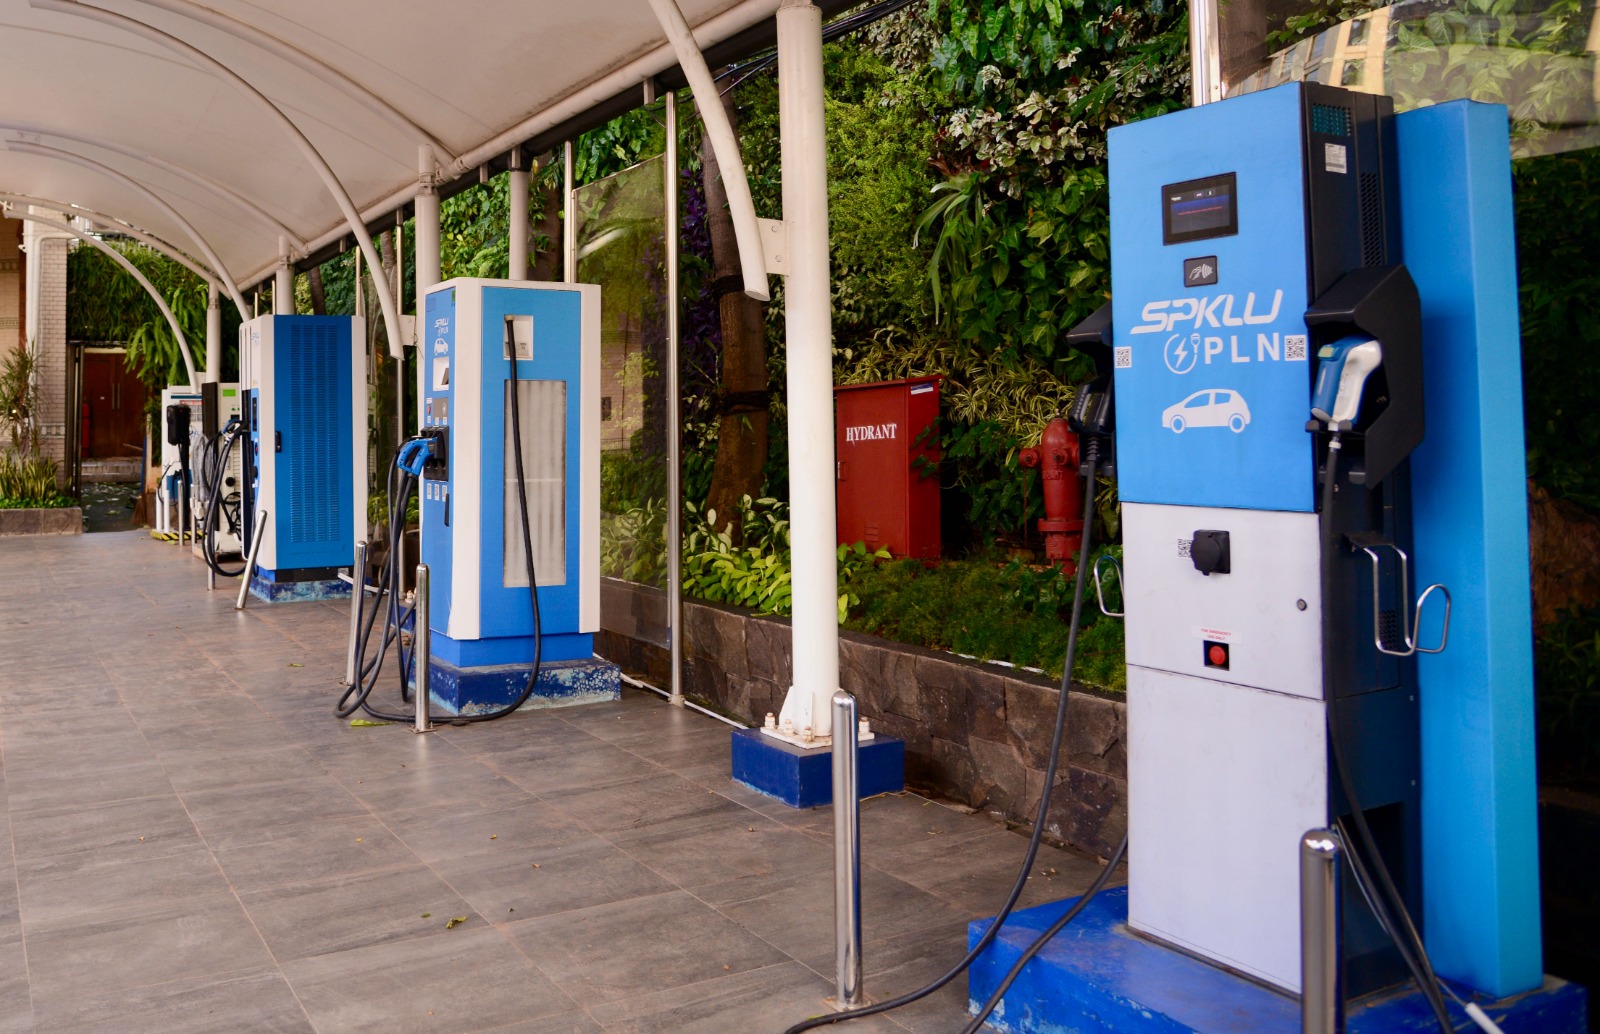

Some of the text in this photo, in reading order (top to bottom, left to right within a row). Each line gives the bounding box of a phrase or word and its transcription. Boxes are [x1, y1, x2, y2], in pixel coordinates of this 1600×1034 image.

[1129, 289, 1284, 335] SPKLU
[1204, 332, 1280, 365] PLN
[845, 423, 897, 442] HYDRANT
